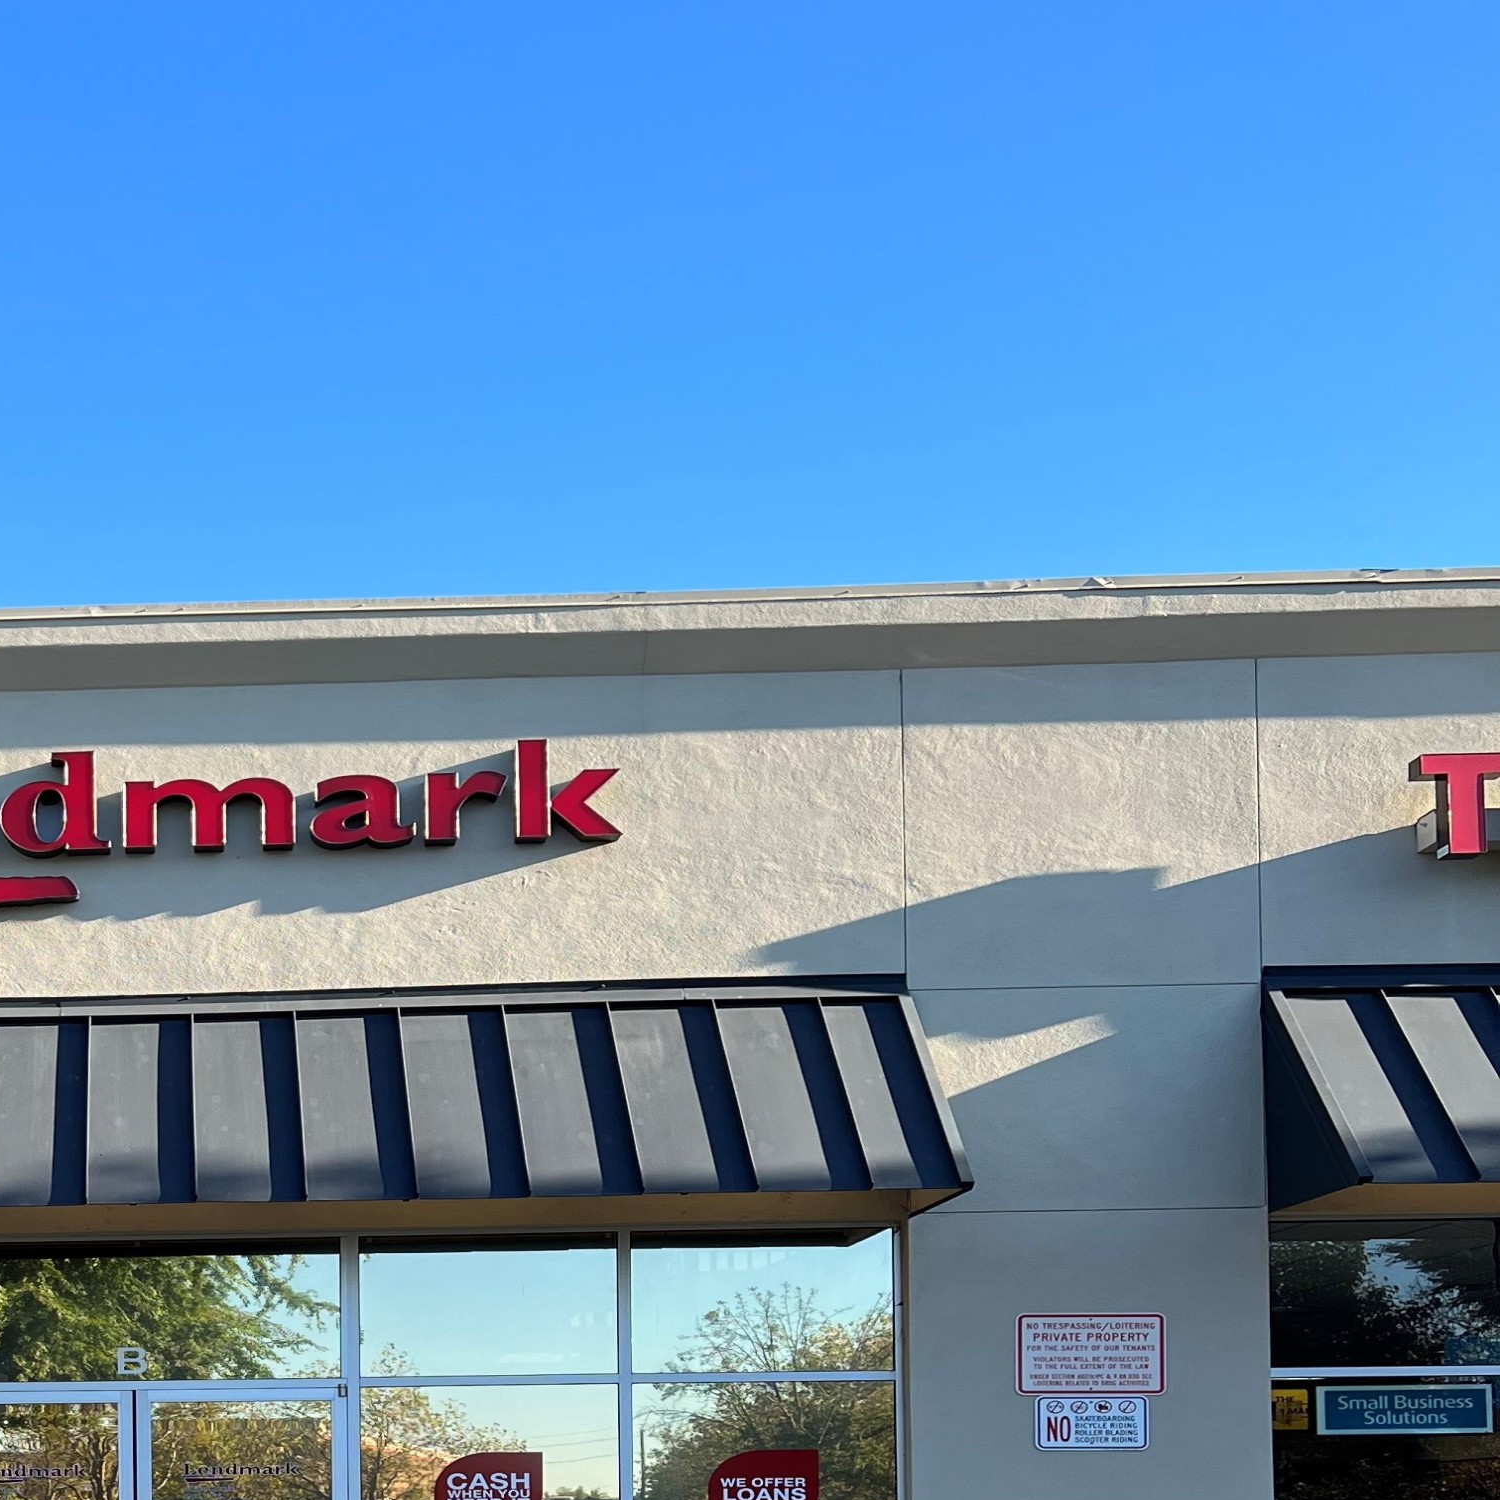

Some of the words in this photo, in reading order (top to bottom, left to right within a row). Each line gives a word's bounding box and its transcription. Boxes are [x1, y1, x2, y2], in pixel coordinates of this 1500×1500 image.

[1026, 1322, 1039, 1330] NO
[1042, 1322, 1156, 1331] TRESPASSING/LOITERING
[1033, 1332, 1082, 1342] PRIVATE
[1086, 1332, 1150, 1342] PROPERTY
[117, 1347, 147, 1376] B
[1337, 1395, 1388, 1410] Small
[1394, 1395, 1474, 1410] Business
[1364, 1410, 1448, 1425] Solutions
[1046, 1416, 1071, 1442] NO
[183, 1462, 300, 1476] Lendmark
[446, 1472, 530, 1490] CASH
[720, 1477, 747, 1487] WE
[751, 1477, 806, 1487] OFFER
[447, 1489, 493, 1498] WHEN
[498, 1489, 531, 1498] YOU
